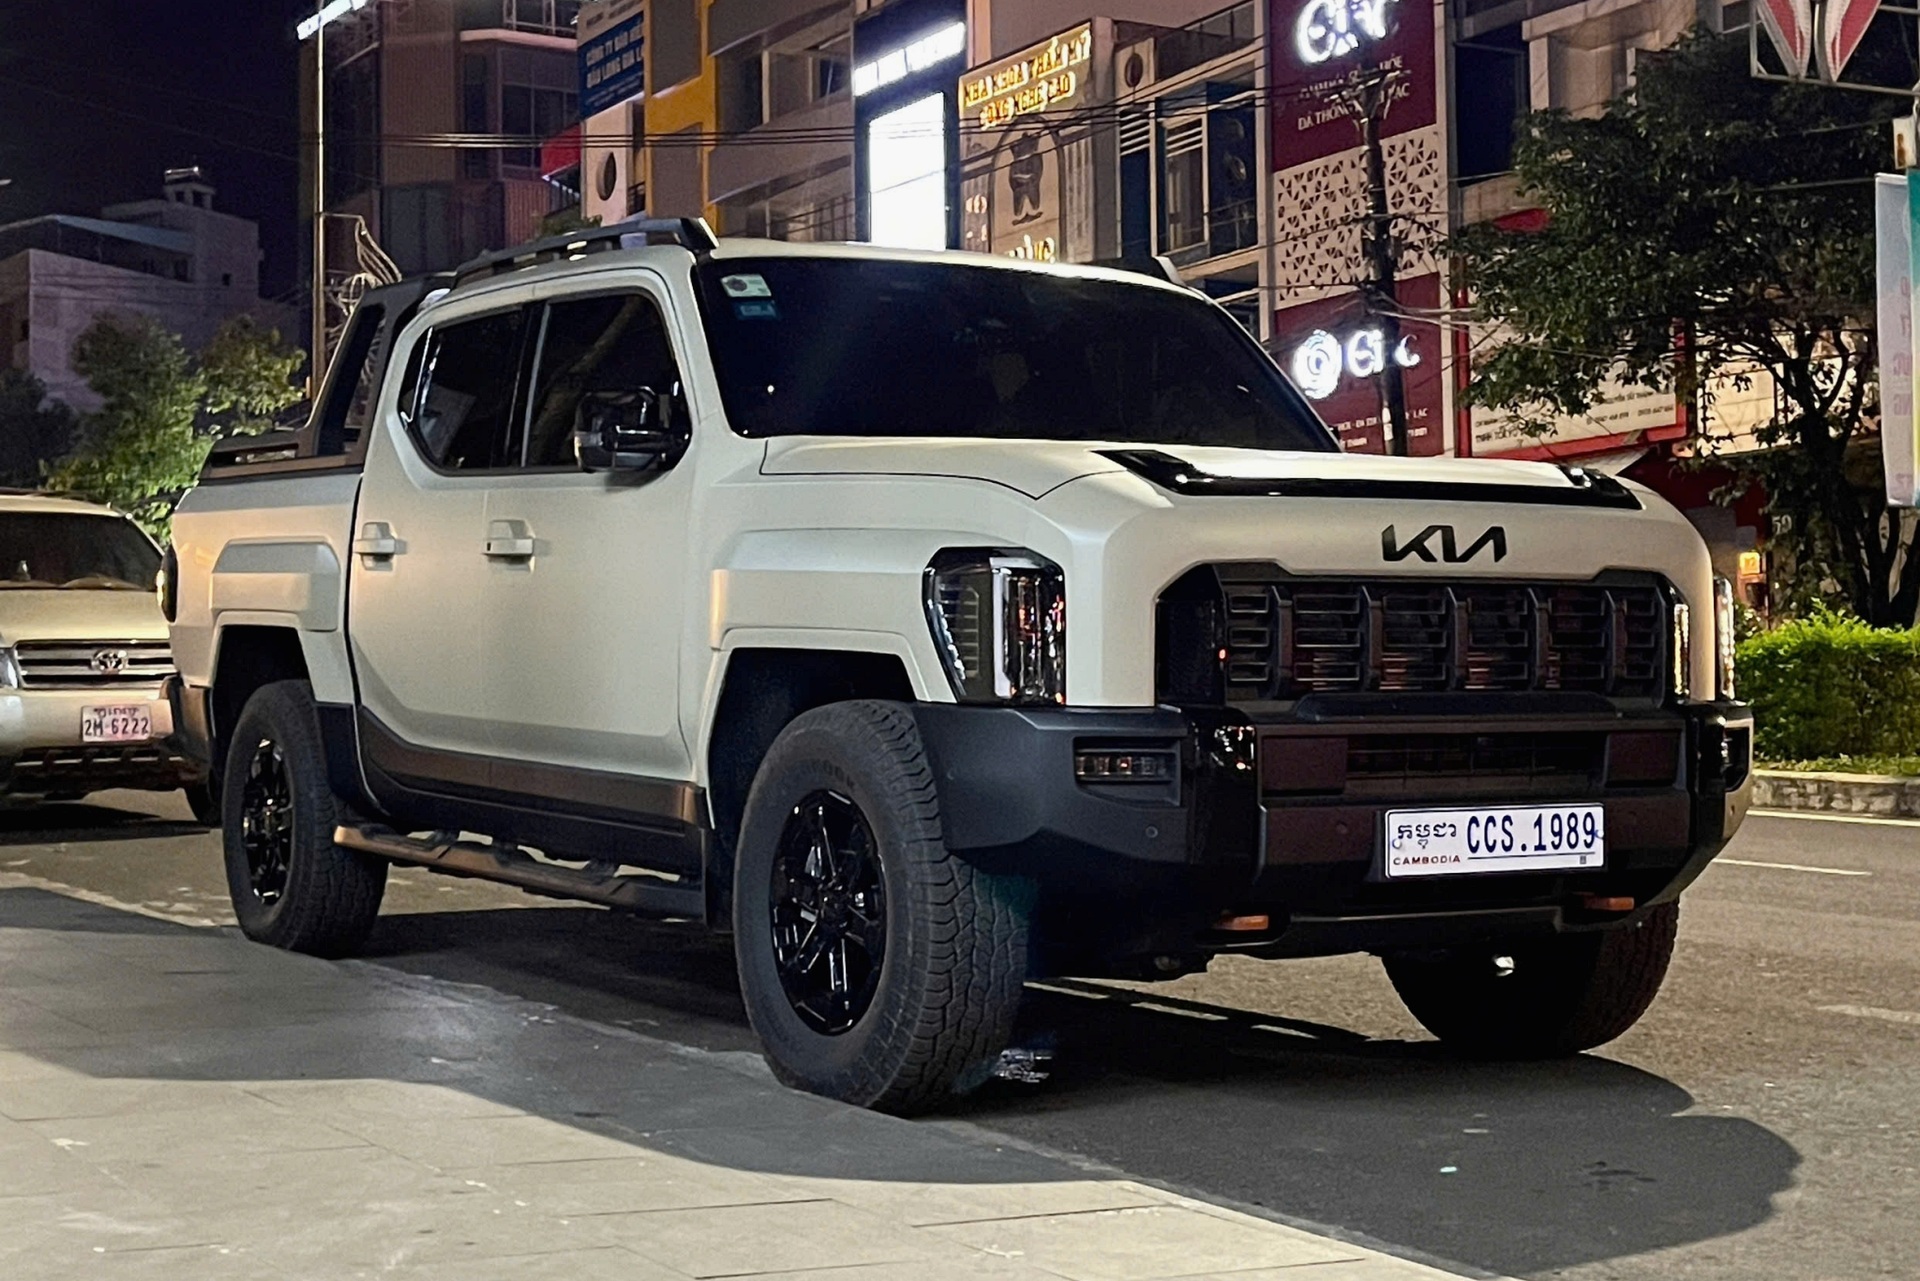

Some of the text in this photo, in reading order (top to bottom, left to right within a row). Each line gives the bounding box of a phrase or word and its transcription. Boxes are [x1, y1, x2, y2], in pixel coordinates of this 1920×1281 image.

[1381, 523, 1507, 563] KIA
[1466, 811, 1596, 854] CCS.1989
[1393, 854, 1461, 866] CAMBODIA
